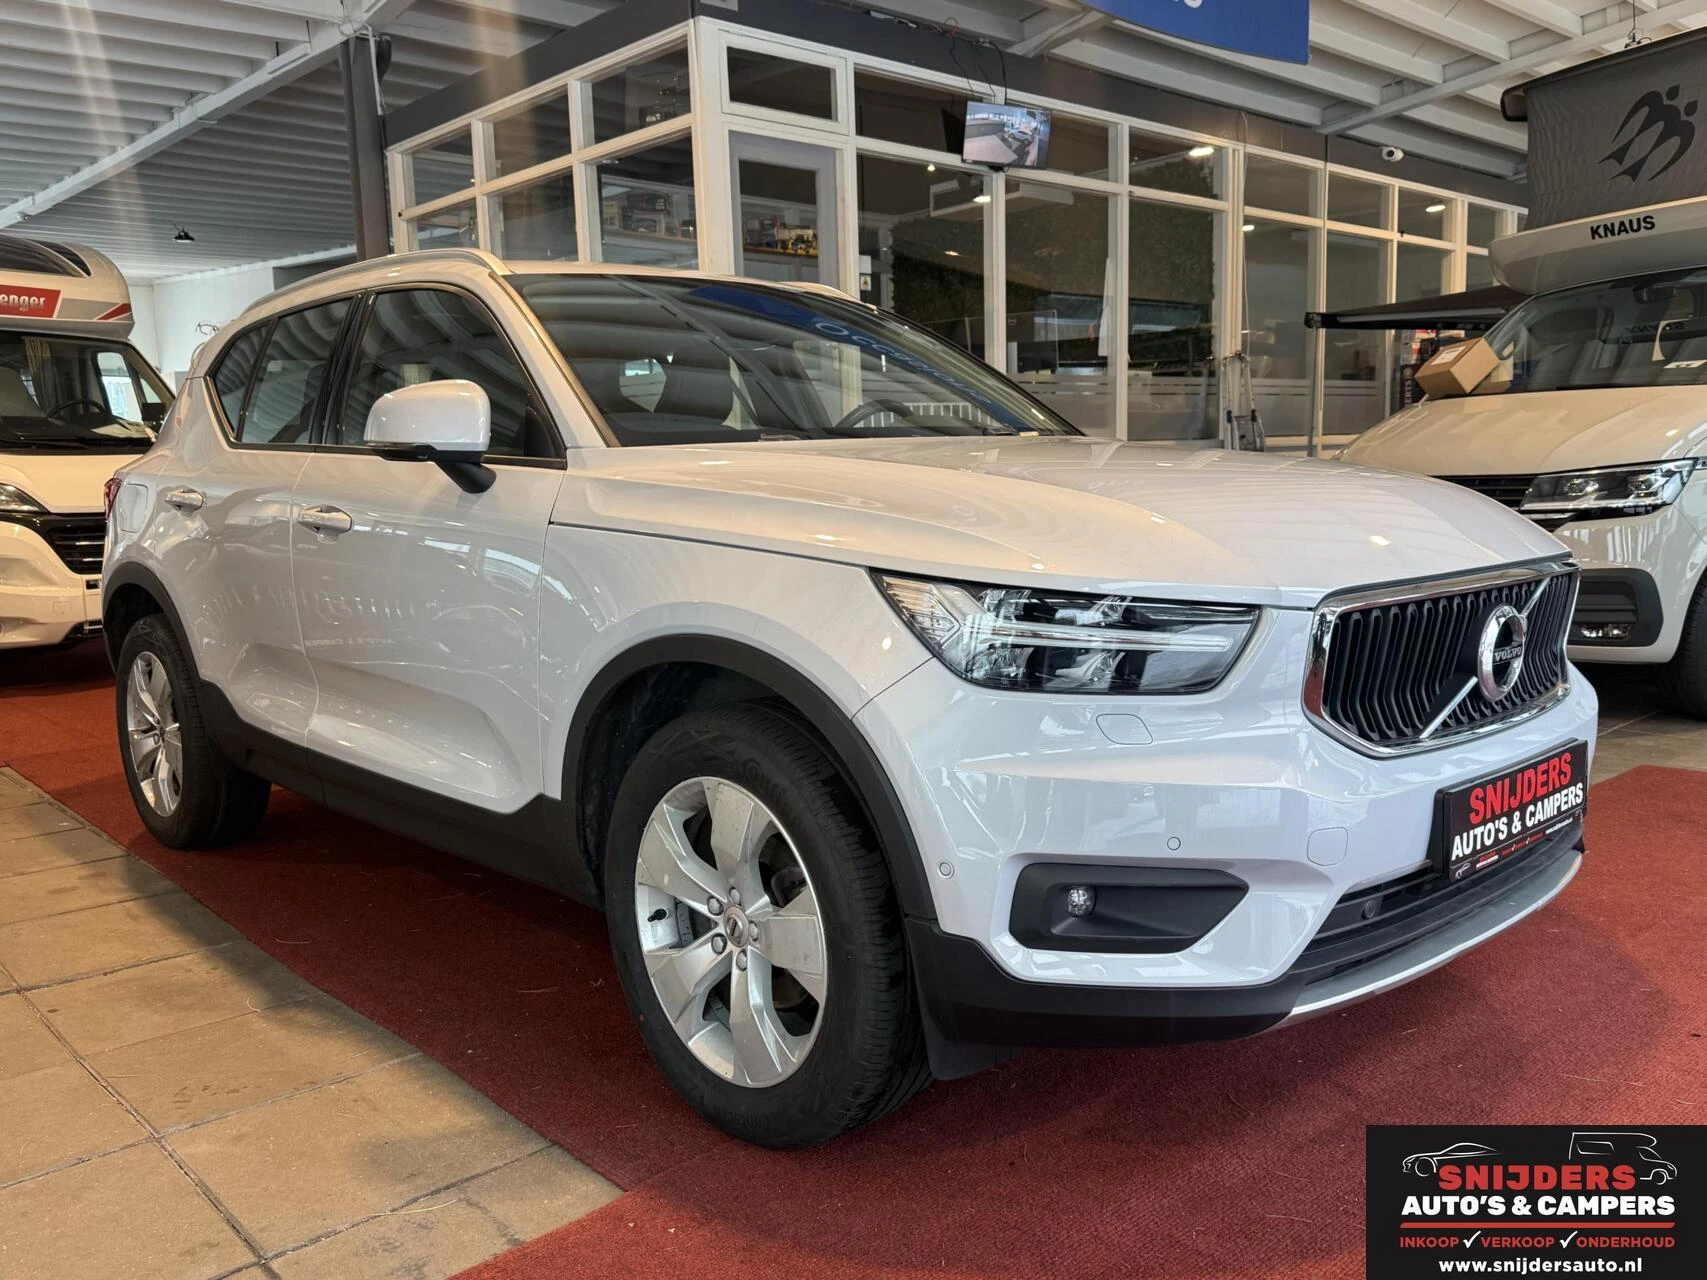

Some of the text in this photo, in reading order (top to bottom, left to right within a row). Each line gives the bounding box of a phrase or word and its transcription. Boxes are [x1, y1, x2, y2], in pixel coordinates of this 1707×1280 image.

[1590, 215, 1656, 240] KNAUS
[1494, 647, 1522, 661] VOLVO
[1469, 752, 1572, 824] SNIJDERS
[1451, 816, 1508, 861] AUTO'S
[1511, 811, 1522, 834] &
[1525, 782, 1584, 827] CAMPERS
